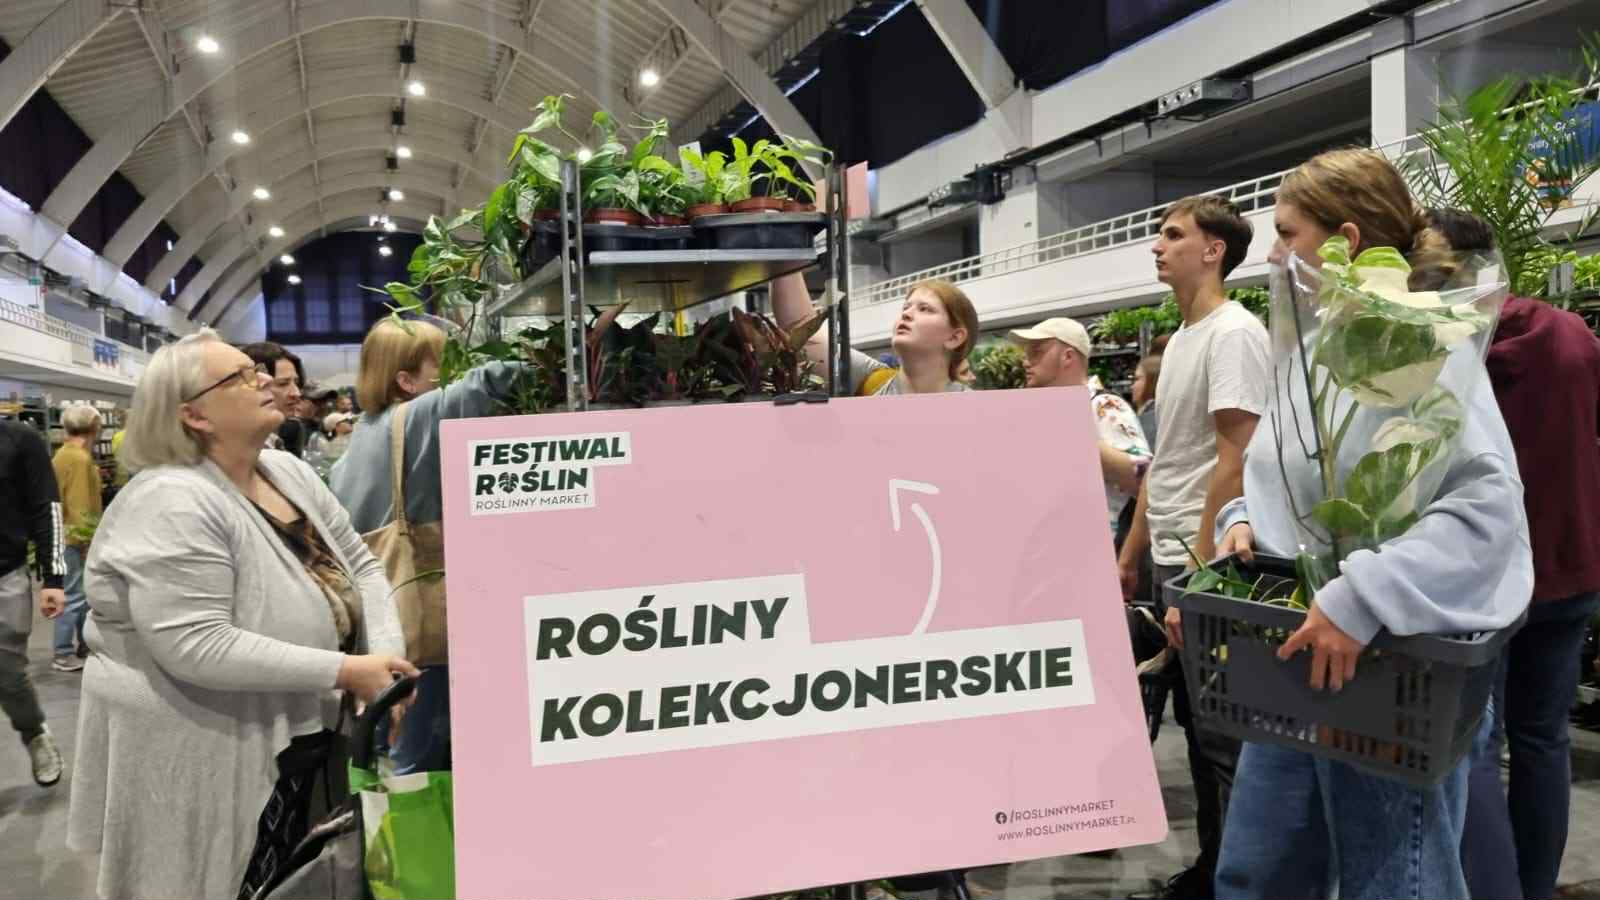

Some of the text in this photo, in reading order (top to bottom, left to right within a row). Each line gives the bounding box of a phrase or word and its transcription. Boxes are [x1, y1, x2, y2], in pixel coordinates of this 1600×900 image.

[474, 437, 626, 466] FESTIWAL
[540, 494, 589, 506] MARKET
[535, 595, 789, 661] ROŚLINY
[540, 646, 1073, 743] KOLEKCJONERSKIE
